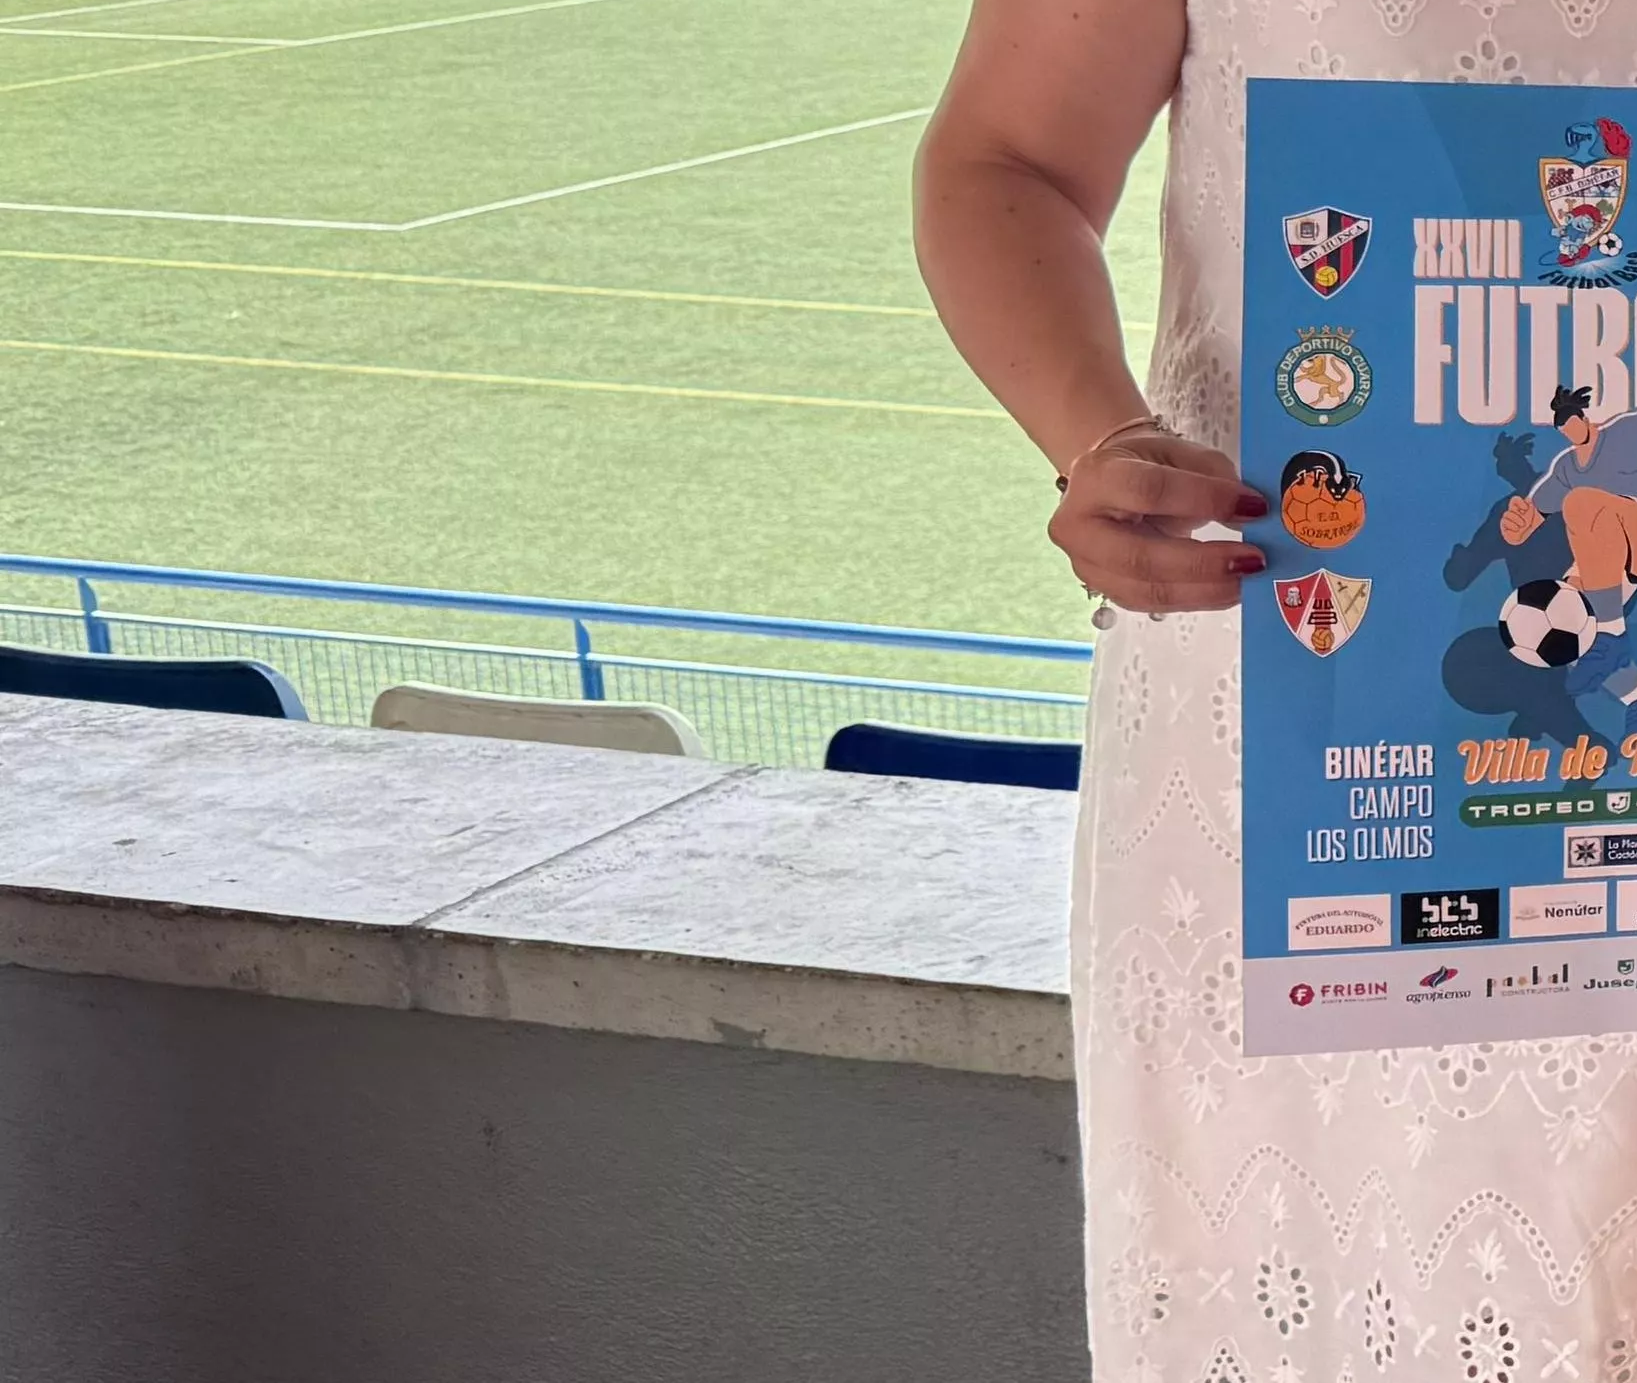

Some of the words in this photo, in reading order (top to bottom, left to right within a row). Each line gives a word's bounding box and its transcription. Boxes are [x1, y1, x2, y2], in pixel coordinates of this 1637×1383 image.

[1321, 224, 1366, 257] HUESCA
[1413, 218, 1523, 279] XXVII
[1280, 337, 1354, 370] DEPORTIVO
[1277, 369, 1296, 408] CLUB
[1350, 348, 1372, 407] CUARTE
[1325, 739, 1436, 781] BINÉFAR
[1457, 736, 1550, 786] Villa
[1558, 733, 1609, 781] de
[1350, 784, 1434, 821] CAMPO
[1468, 799, 1595, 818] TROFEO
[1307, 828, 1347, 863] LOS
[1353, 825, 1435, 861] OLMOS
[1544, 903, 1604, 919] Nenúfar
[1306, 924, 1375, 936] EDUARDO
[1321, 980, 1388, 998] FRIBIN
